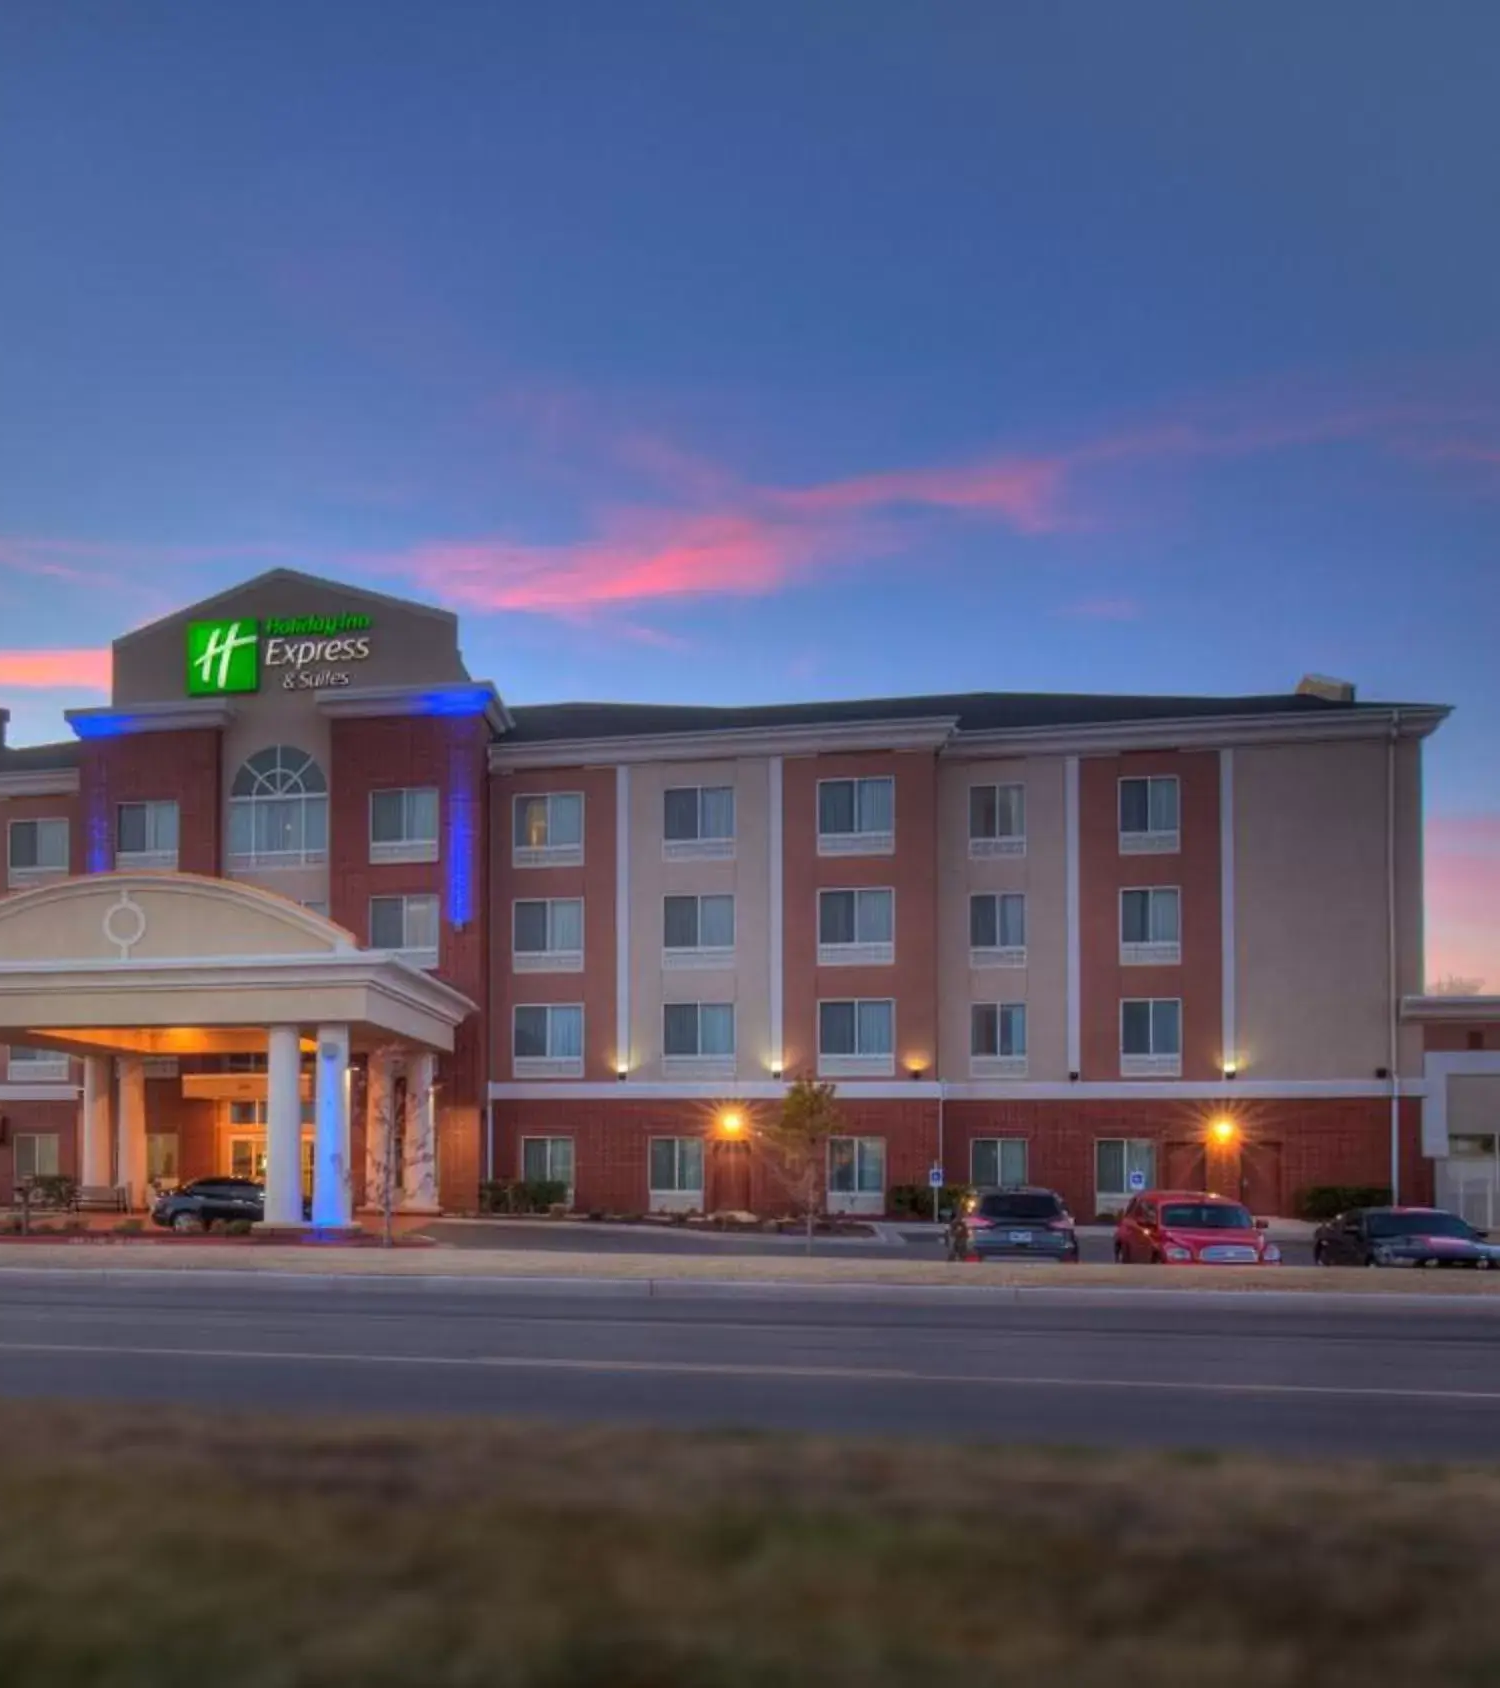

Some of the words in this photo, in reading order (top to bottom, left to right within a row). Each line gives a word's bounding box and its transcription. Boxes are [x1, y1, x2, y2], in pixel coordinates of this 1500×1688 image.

[266, 613, 337, 635] Holiday
[340, 611, 370, 630] Inn
[265, 637, 370, 669] Express
[282, 671, 295, 689] &
[300, 670, 350, 689] Suites
